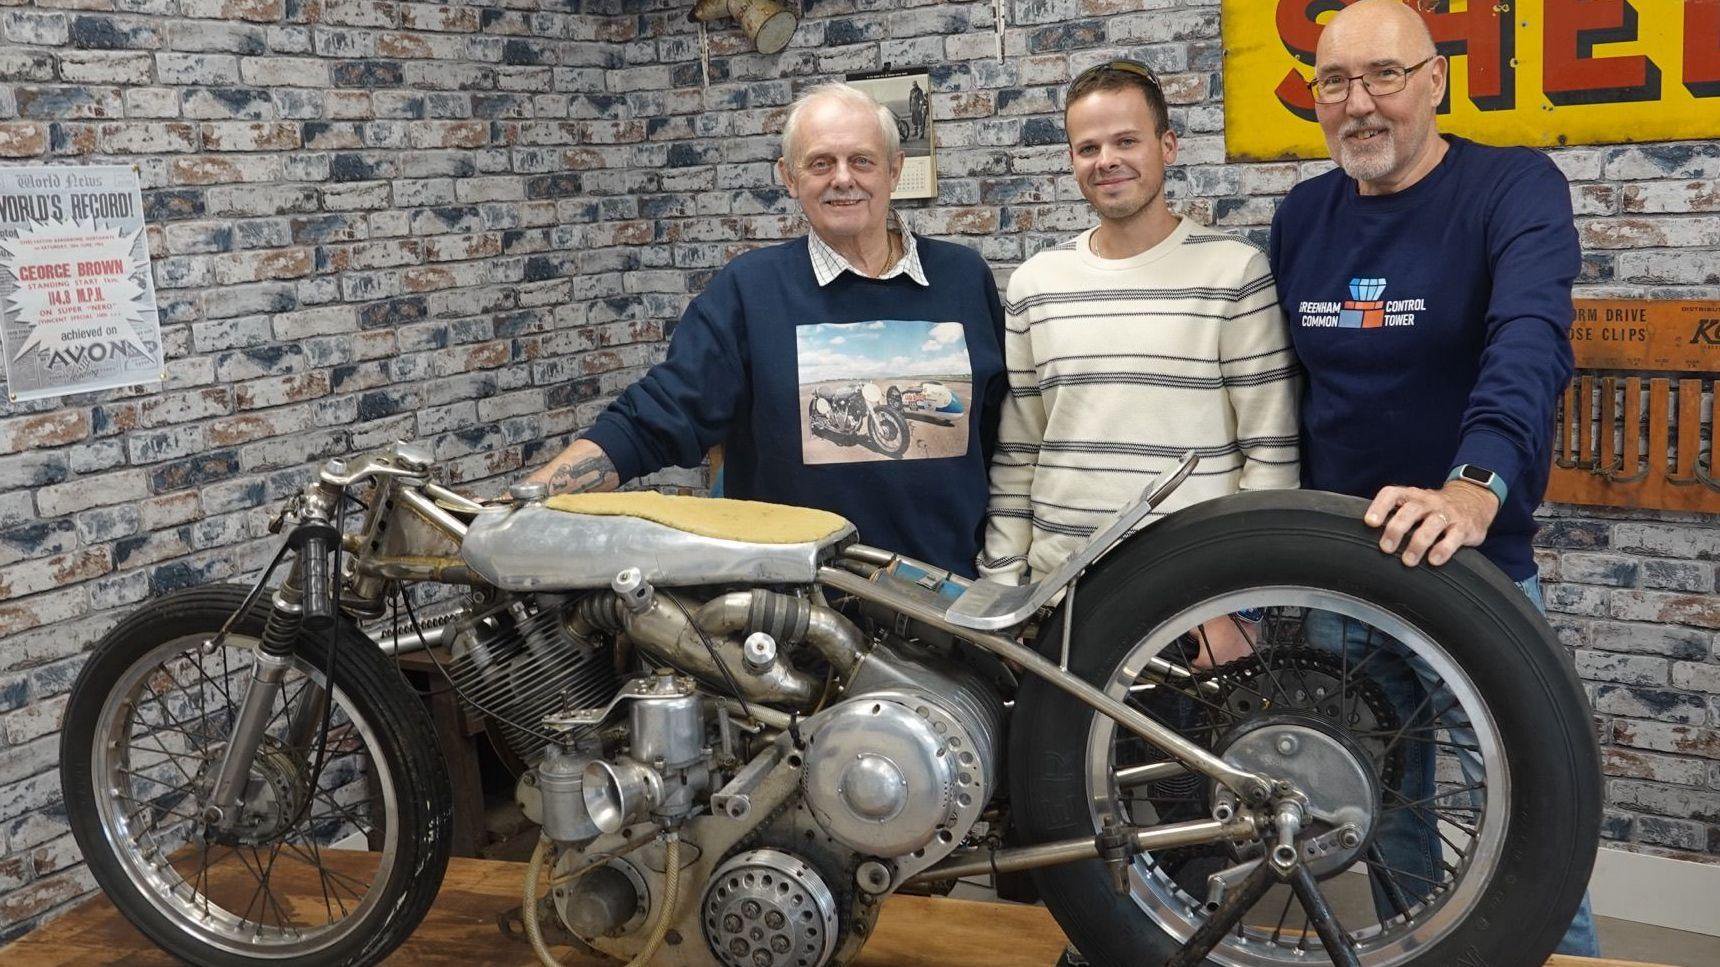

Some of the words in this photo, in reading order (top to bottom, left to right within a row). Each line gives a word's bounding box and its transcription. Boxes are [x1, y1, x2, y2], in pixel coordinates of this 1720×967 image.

[71, 193, 134, 219] RECORD!
[20, 263, 71, 281] GEORGE
[77, 259, 124, 277] BROWN
[28, 281, 70, 290] STANDING
[75, 278, 99, 286] START
[1386, 299, 1426, 312] CONTROL
[40, 309, 52, 317] ON
[1606, 308, 1647, 321] DRIVE
[1302, 315, 1339, 327] COMMON
[1384, 314, 1415, 326] TOWER
[61, 326, 103, 341] achieved
[106, 327, 118, 336] on
[1602, 328, 1646, 341] CLIPS
[48, 340, 128, 369] AVON
